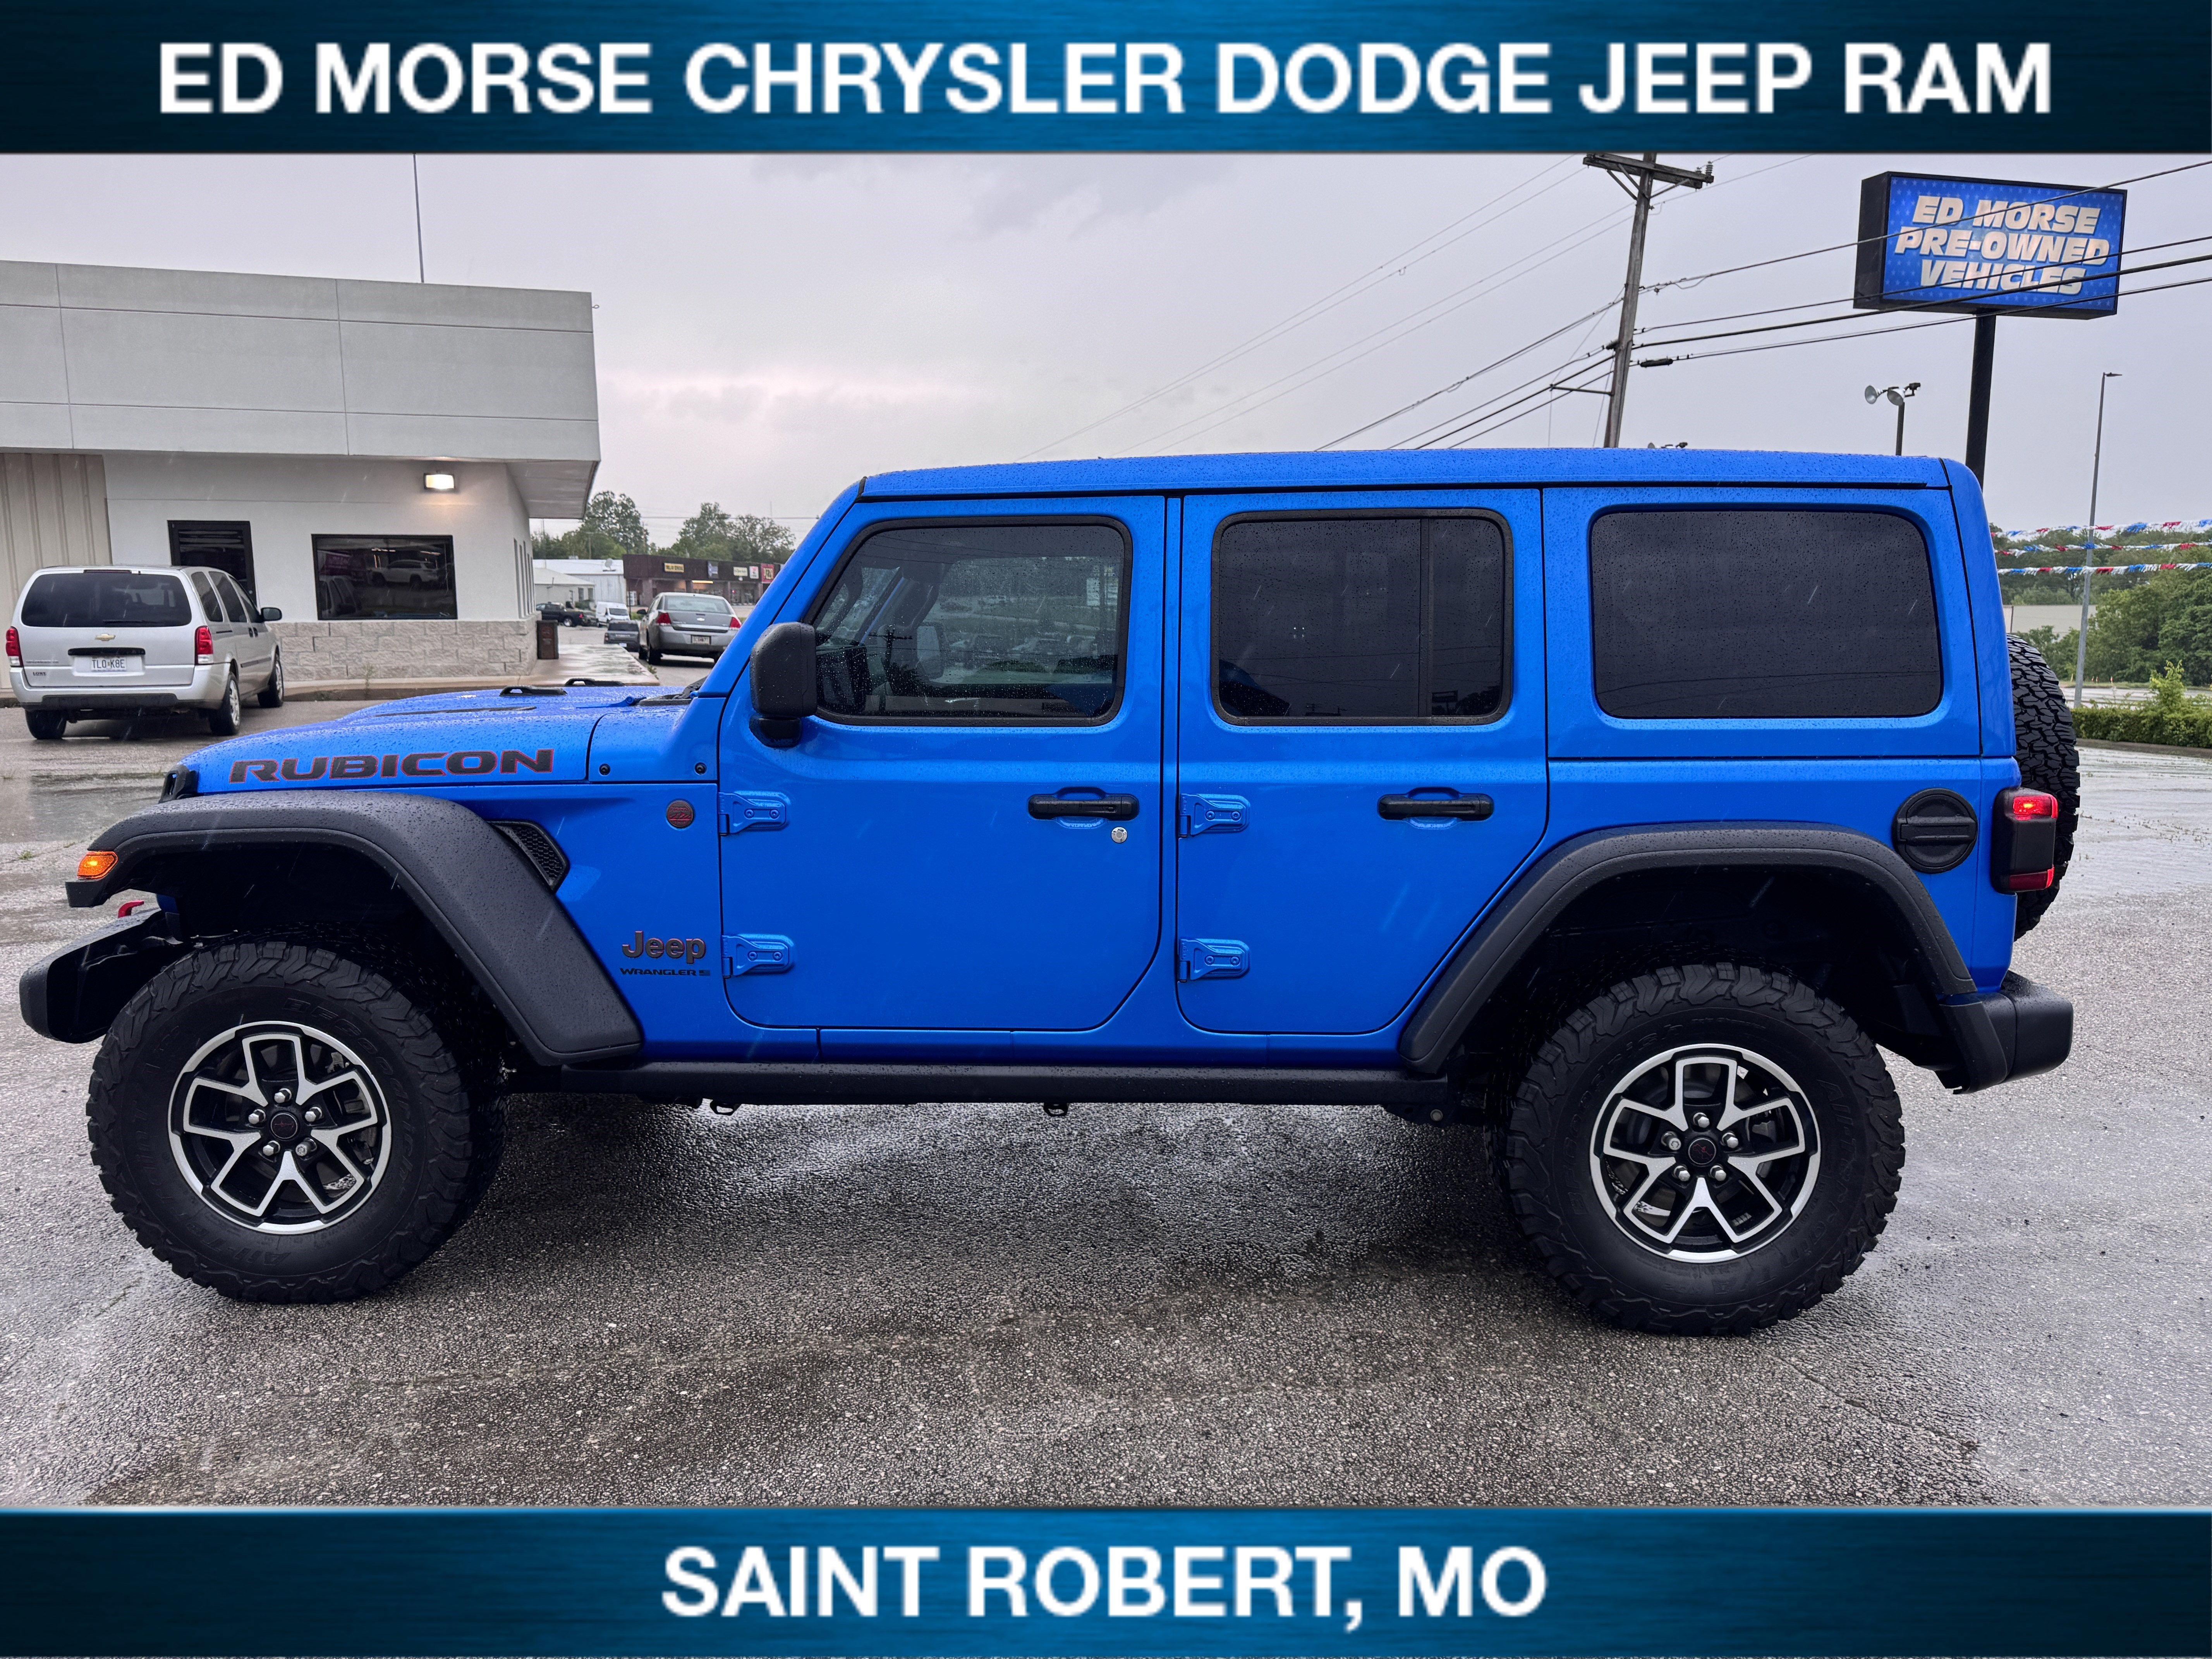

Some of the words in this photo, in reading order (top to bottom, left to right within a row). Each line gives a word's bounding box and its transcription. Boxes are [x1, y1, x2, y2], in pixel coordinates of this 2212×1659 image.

[1912, 195, 1963, 225] ED
[1973, 199, 2101, 235] MORSE
[1894, 226, 2110, 266] PRE-OWNED
[1920, 259, 2087, 295] VEHICLES
[228, 748, 554, 784] RUBICON
[622, 930, 706, 965] Jeep
[620, 968, 697, 976] WRANGLER
